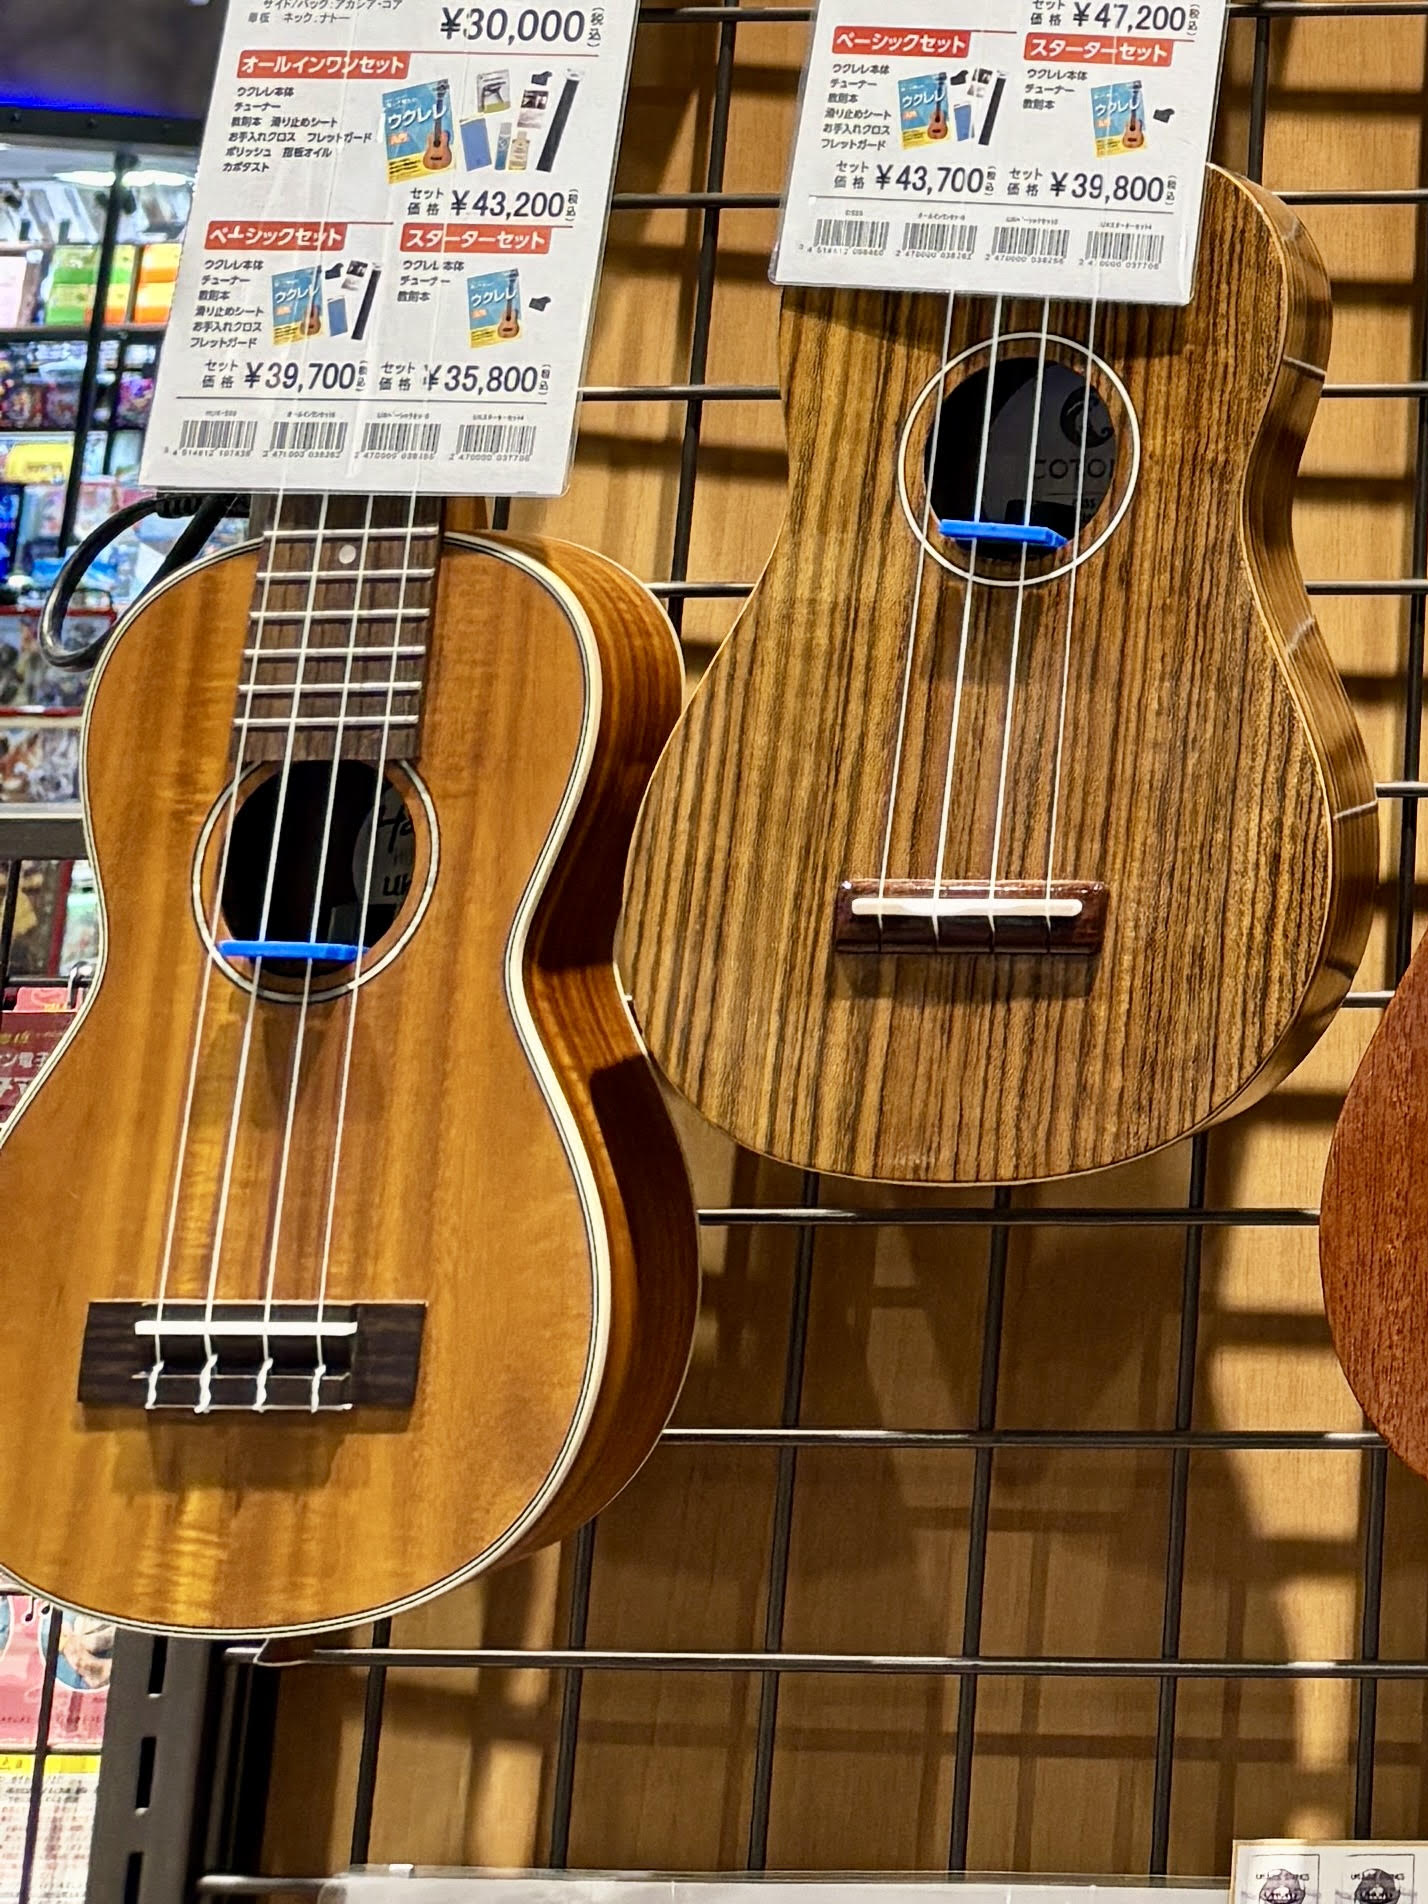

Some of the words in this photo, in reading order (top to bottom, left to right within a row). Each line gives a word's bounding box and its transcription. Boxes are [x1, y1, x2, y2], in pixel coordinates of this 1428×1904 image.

[437, 7, 586, 44] ¥30,000
[1070, 2, 1188, 35] ¥47,200
[834, 31, 967, 55] ベーシックセット
[1029, 39, 1168, 63] スターターセット
[239, 53, 405, 75] オールインワンセット
[873, 162, 985, 197] ¥43,700
[1048, 170, 1166, 206] ¥39,800
[448, 189, 567, 221] ¥43,200
[405, 229, 547, 251] スターターセット
[242, 360, 358, 392] ¥39,700
[421, 362, 539, 395] ¥35,800
